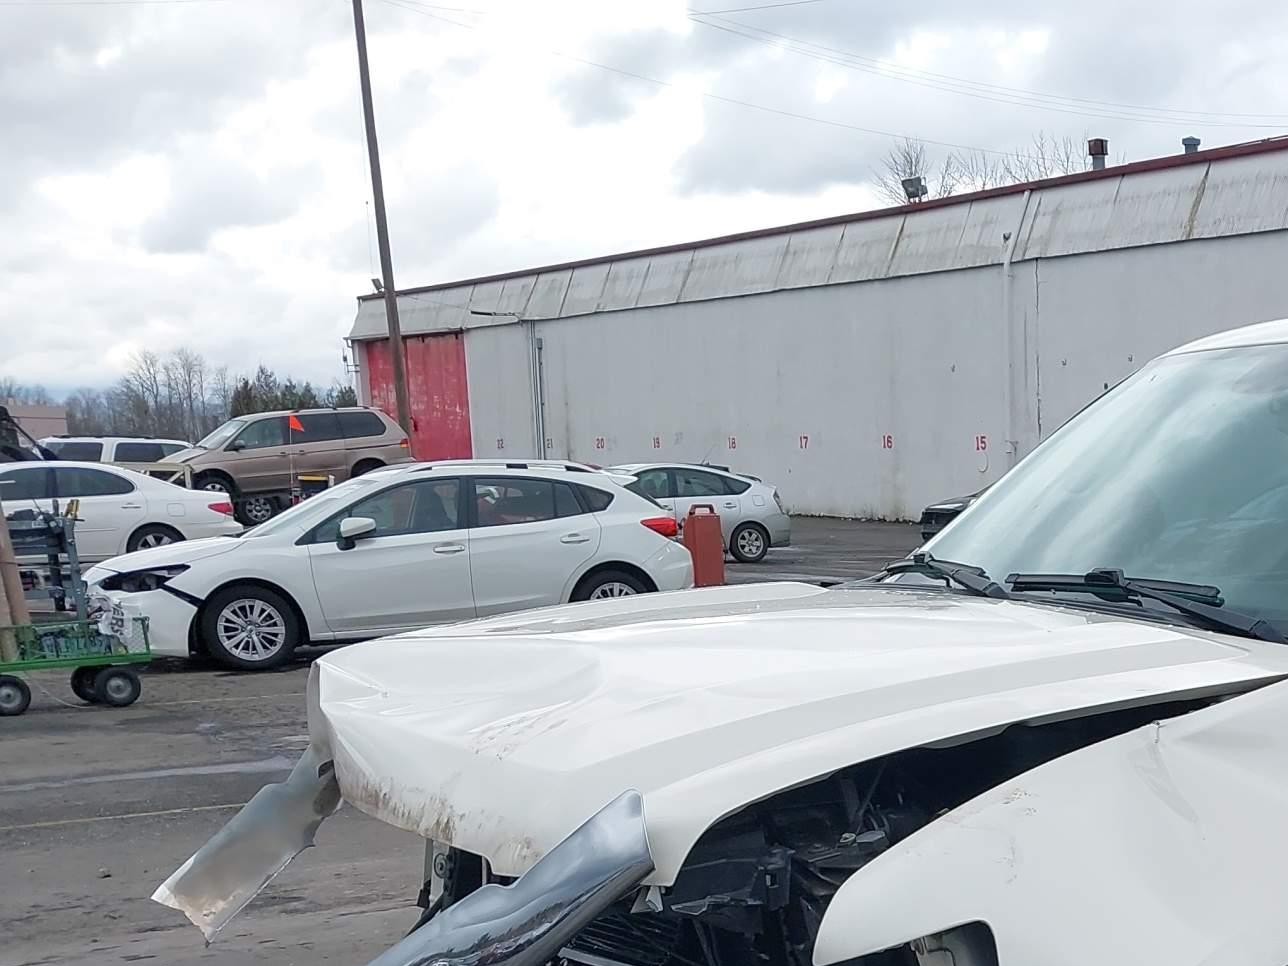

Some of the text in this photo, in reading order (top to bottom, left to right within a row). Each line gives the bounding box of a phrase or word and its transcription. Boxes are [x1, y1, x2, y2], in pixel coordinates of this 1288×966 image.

[596, 438, 605, 449] 20
[652, 437, 661, 449] 19
[728, 437, 737, 449] 18
[799, 436, 809, 449] 17
[882, 435, 893, 449] 16
[975, 436, 987, 450] 15
